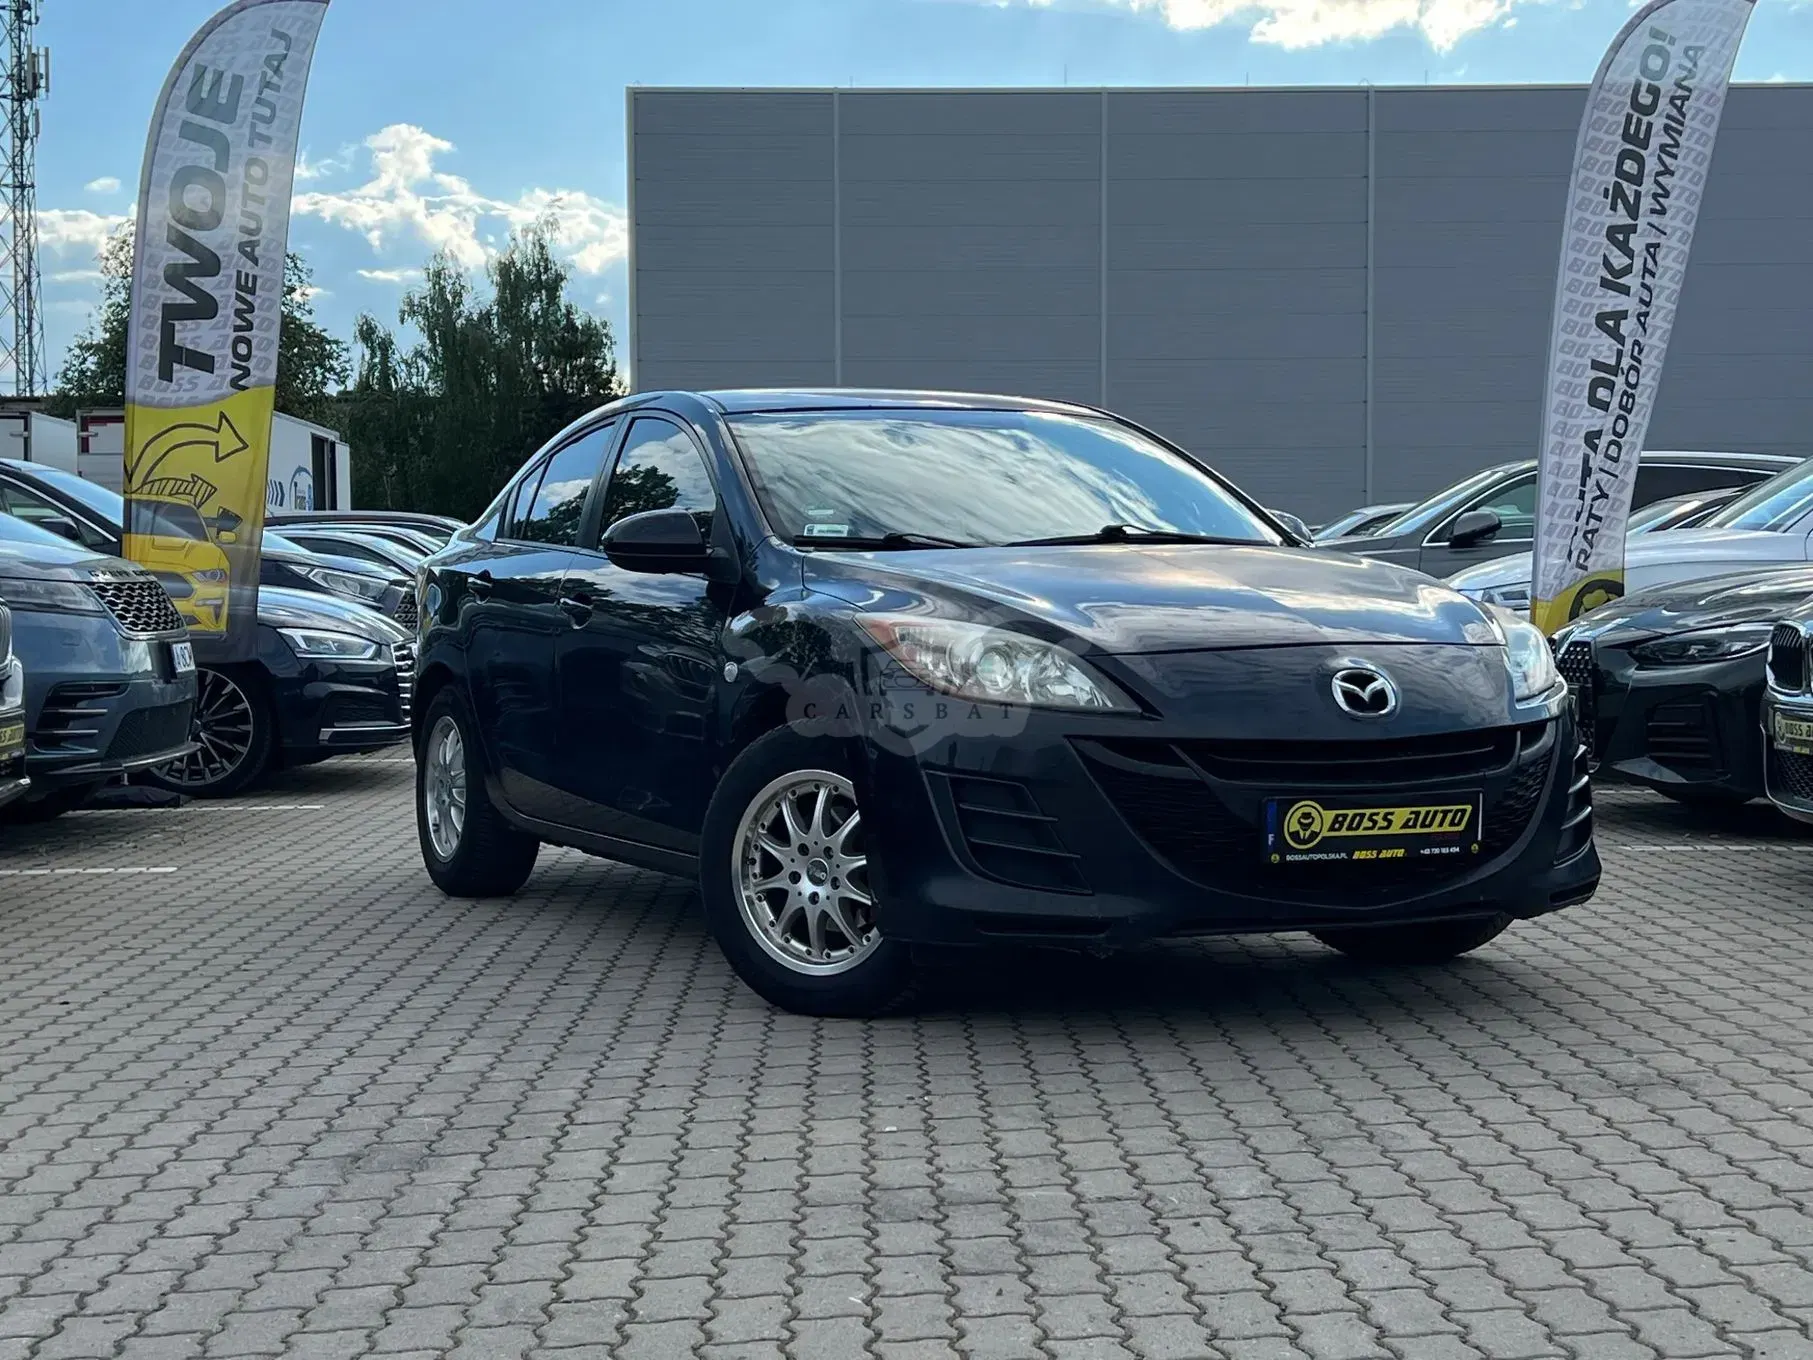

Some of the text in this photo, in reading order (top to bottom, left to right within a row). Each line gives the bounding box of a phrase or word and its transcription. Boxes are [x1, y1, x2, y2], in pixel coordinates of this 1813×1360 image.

[248, 28, 292, 148] TUTAJ
[238, 157, 268, 267] AUTO
[1600, 26, 1677, 297] KAŻDEGO!
[158, 63, 244, 384] TWOJE
[230, 269, 257, 391] NOWE
[1575, 480, 1609, 571] RATY
[1603, 339, 1646, 464] DOBÓR
[1636, 242, 1661, 336] AUTA
[1650, 45, 1705, 216] WYMIANA
[1587, 310, 1629, 413] DLA
[1327, 808, 1468, 832] BOSS AUTO
[1352, 848, 1405, 860] BOSS AUTO
